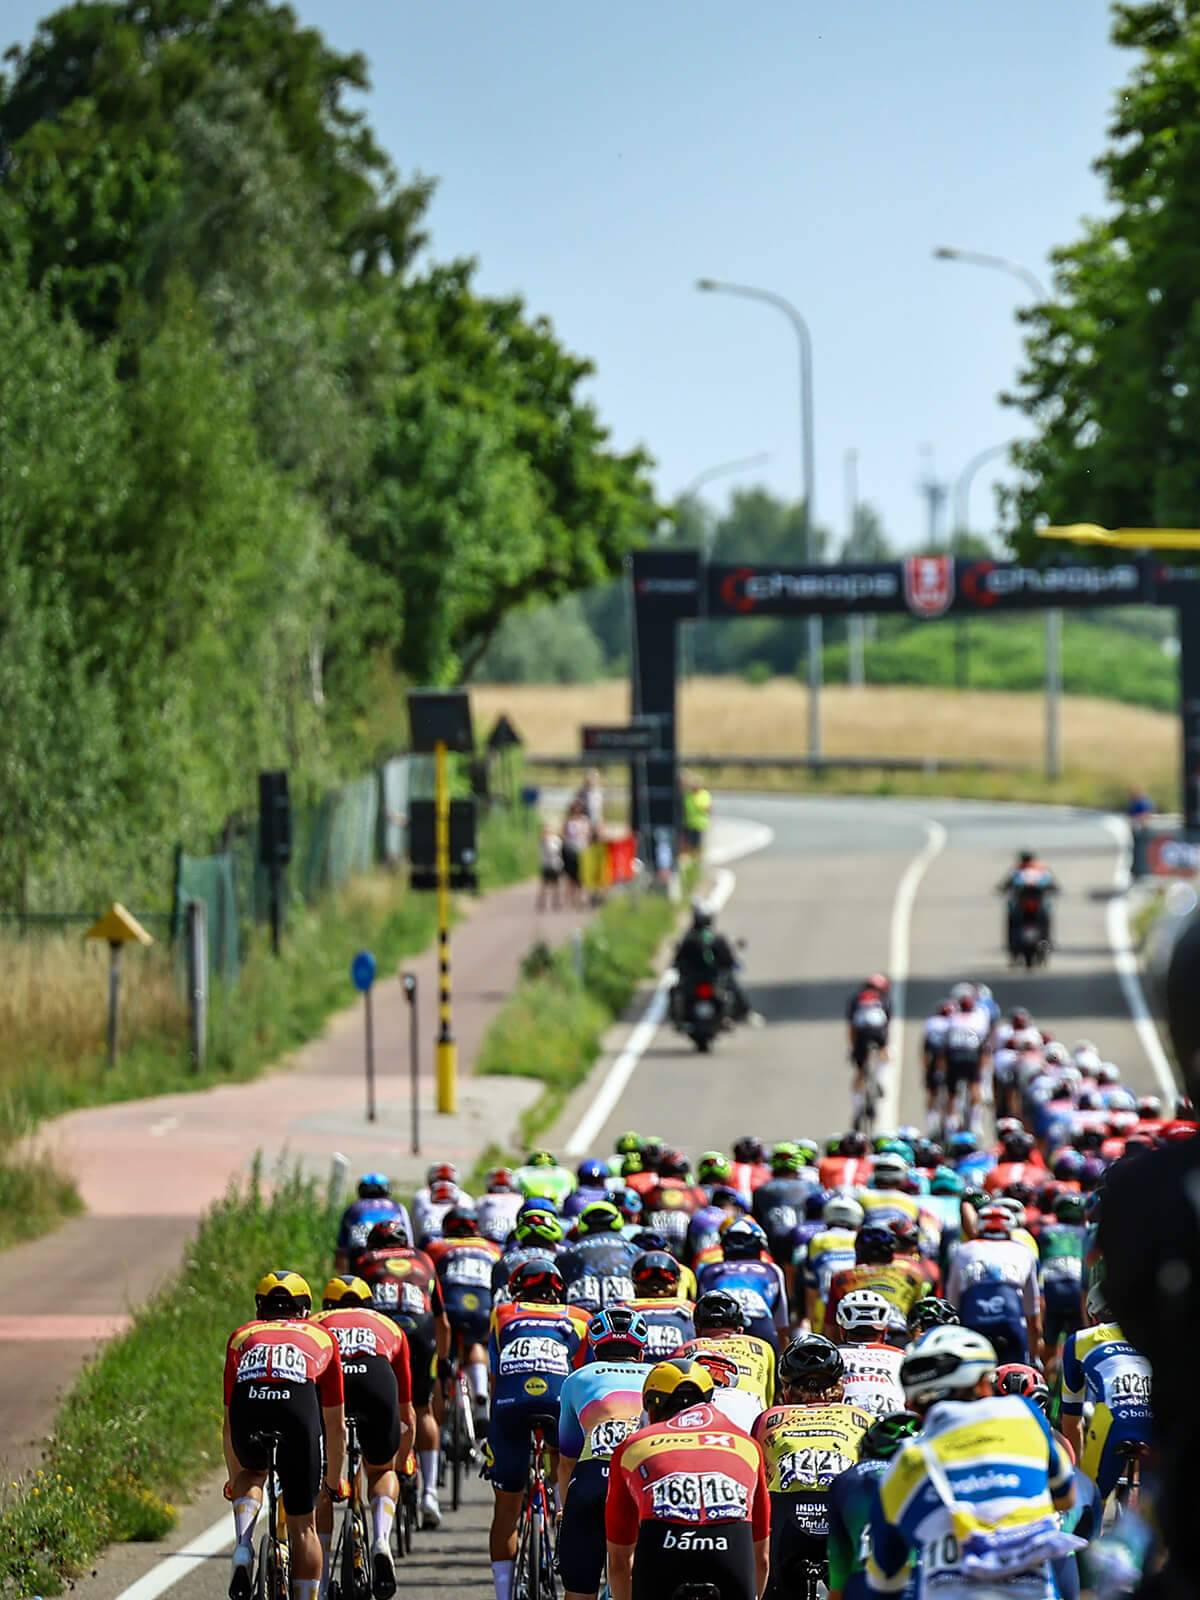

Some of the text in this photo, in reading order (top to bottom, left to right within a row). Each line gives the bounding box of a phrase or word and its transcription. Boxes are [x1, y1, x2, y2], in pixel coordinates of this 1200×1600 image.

[509, 1340, 531, 1358] 46
[540, 1339, 560, 1358] 46
[650, 1437, 693, 1447] Uno
